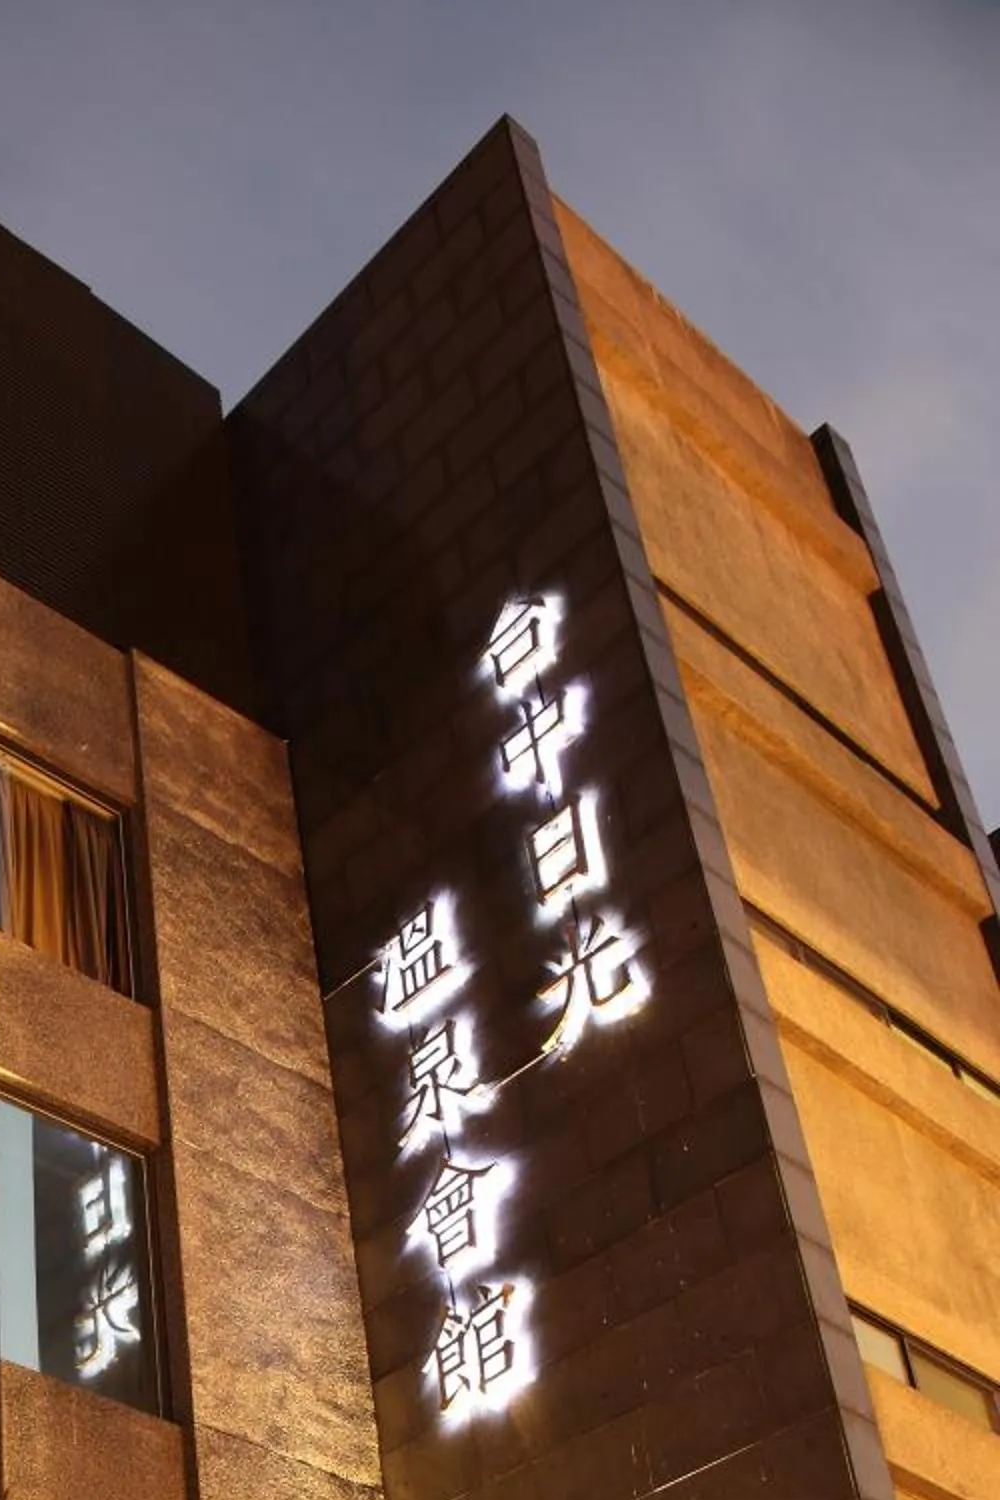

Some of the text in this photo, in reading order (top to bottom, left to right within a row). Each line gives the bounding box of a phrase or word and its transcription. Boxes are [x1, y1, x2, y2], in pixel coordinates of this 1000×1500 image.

[480, 594, 642, 1054] 台中日光
[374, 895, 522, 1415] 溫泉會館
